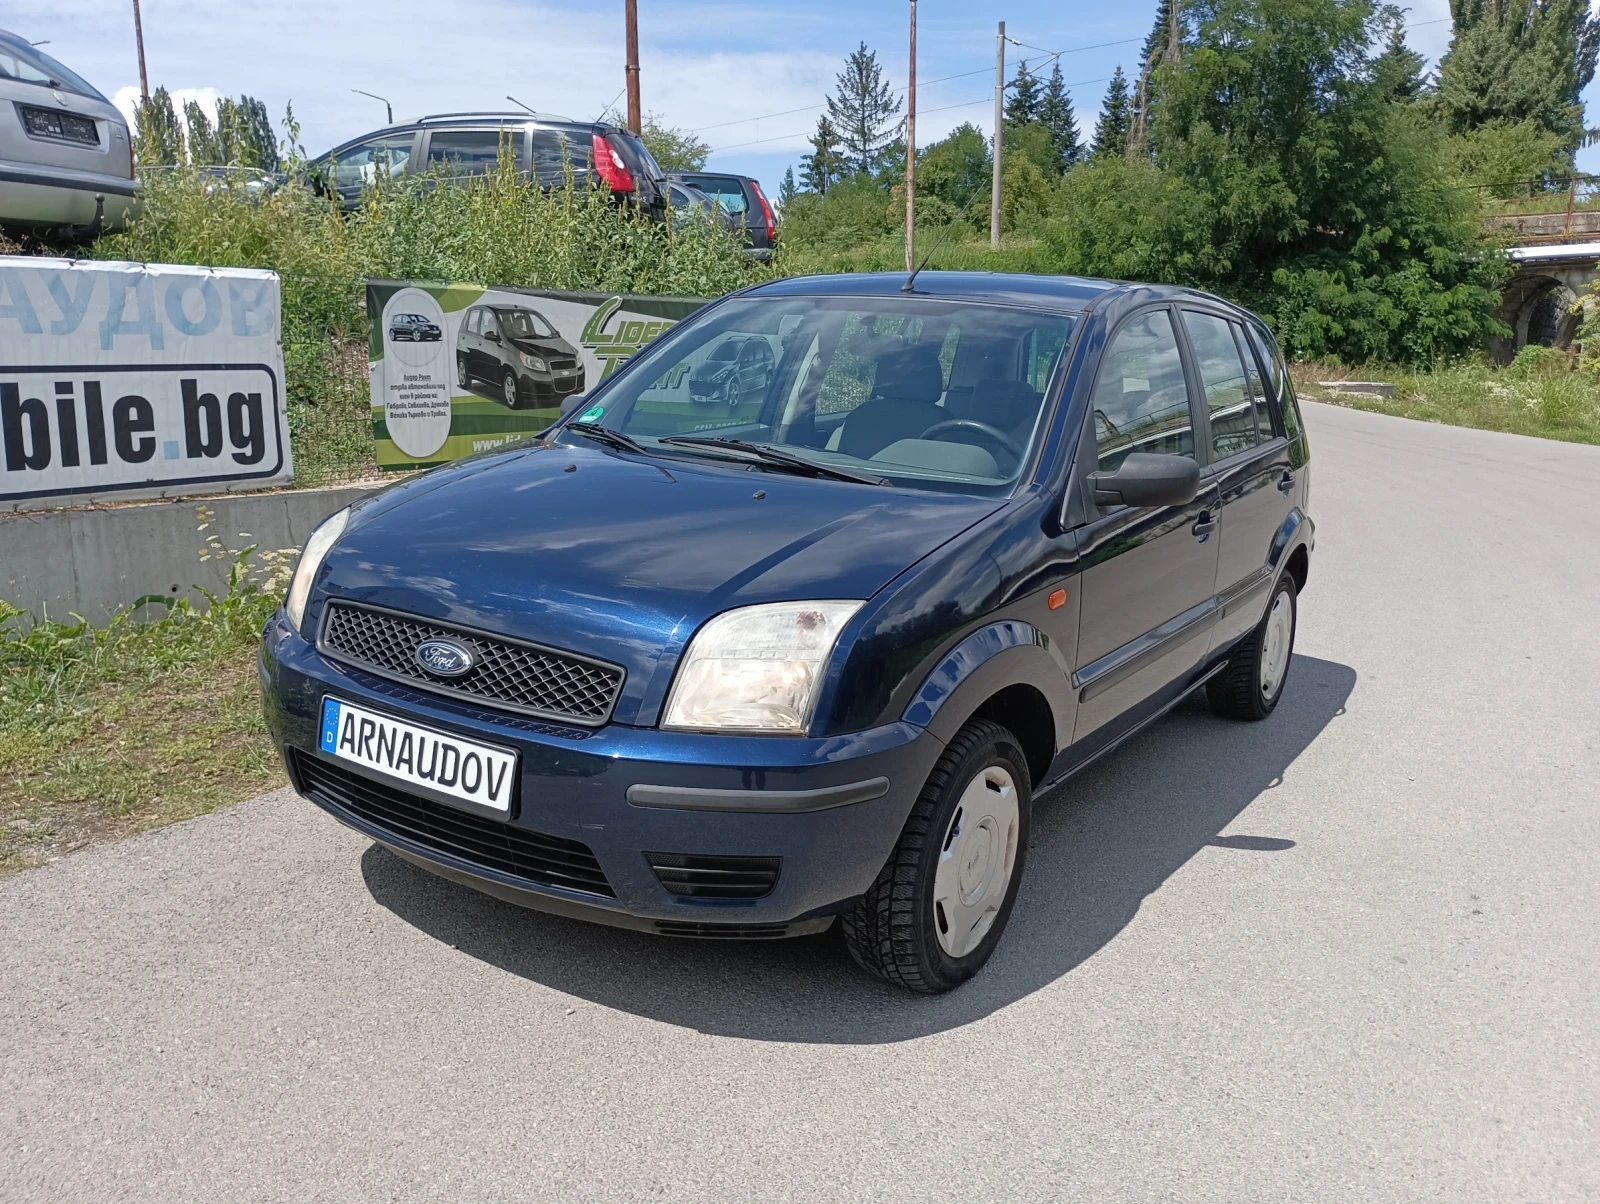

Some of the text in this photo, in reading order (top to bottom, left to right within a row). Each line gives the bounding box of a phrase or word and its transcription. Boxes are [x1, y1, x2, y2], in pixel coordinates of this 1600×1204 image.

[580, 296, 679, 343] LIDE
[425, 647, 457, 668] Ford
[326, 712, 508, 802] D ARNAUDOV
